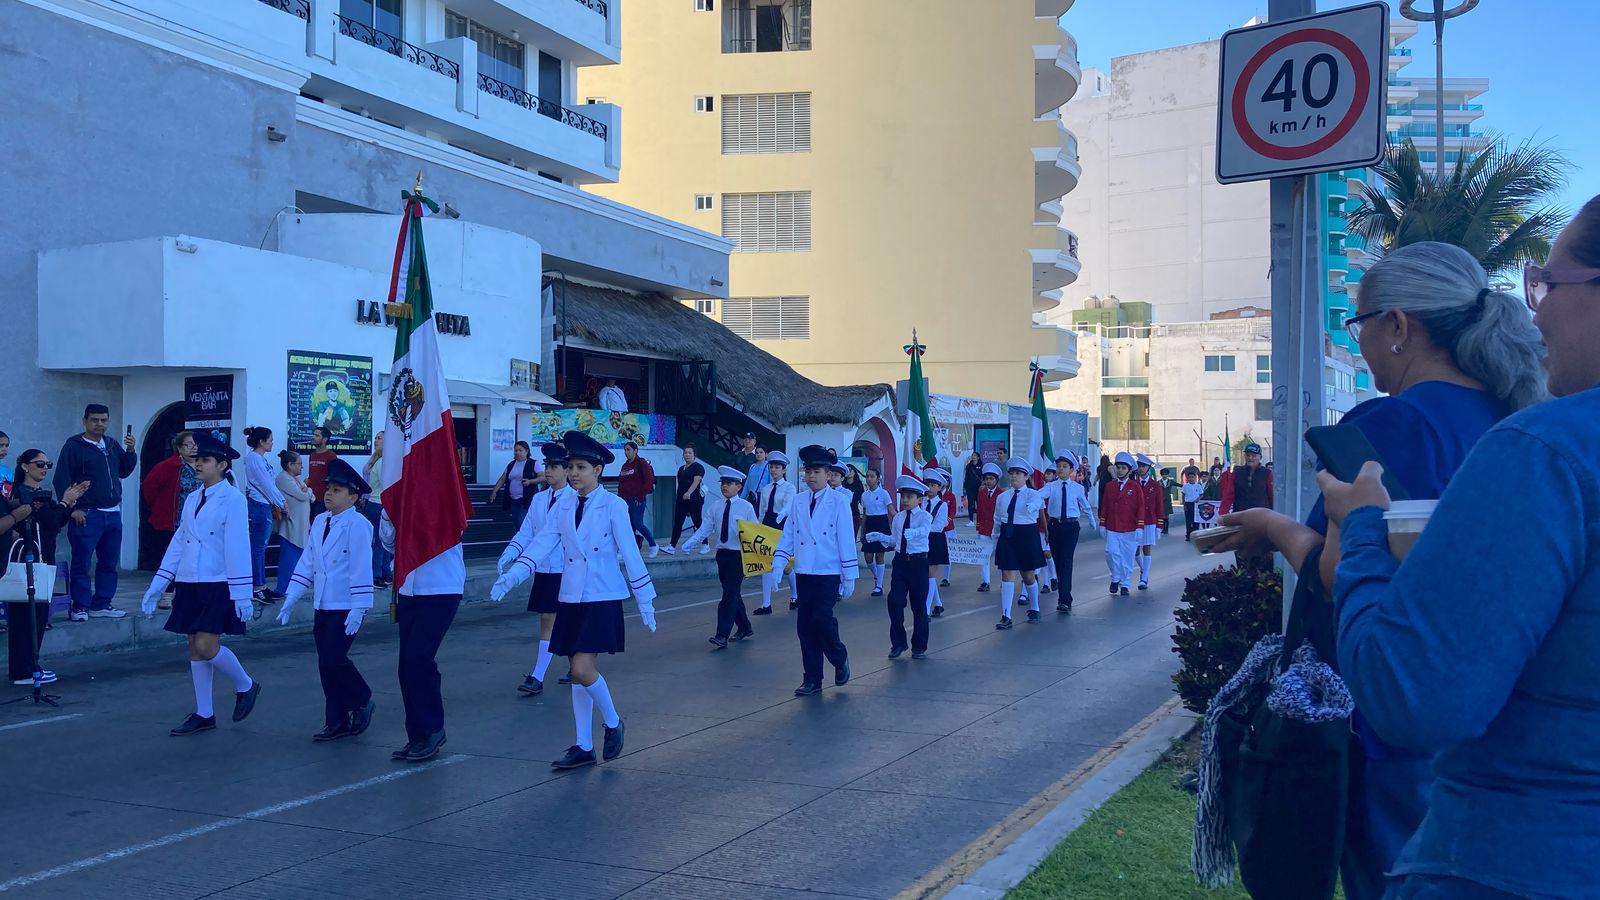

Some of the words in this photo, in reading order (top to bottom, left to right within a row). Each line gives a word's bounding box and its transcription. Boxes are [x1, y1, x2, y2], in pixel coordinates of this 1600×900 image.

[1260, 53, 1339, 112] 40
[1269, 114, 1326, 134] km/h
[356, 299, 382, 324] LA
[190, 391, 229, 402] VENTANITA
[201, 400, 217, 410] BAR
[948, 538, 977, 546] PRIMARIA
[746, 563, 764, 572] ZONA
